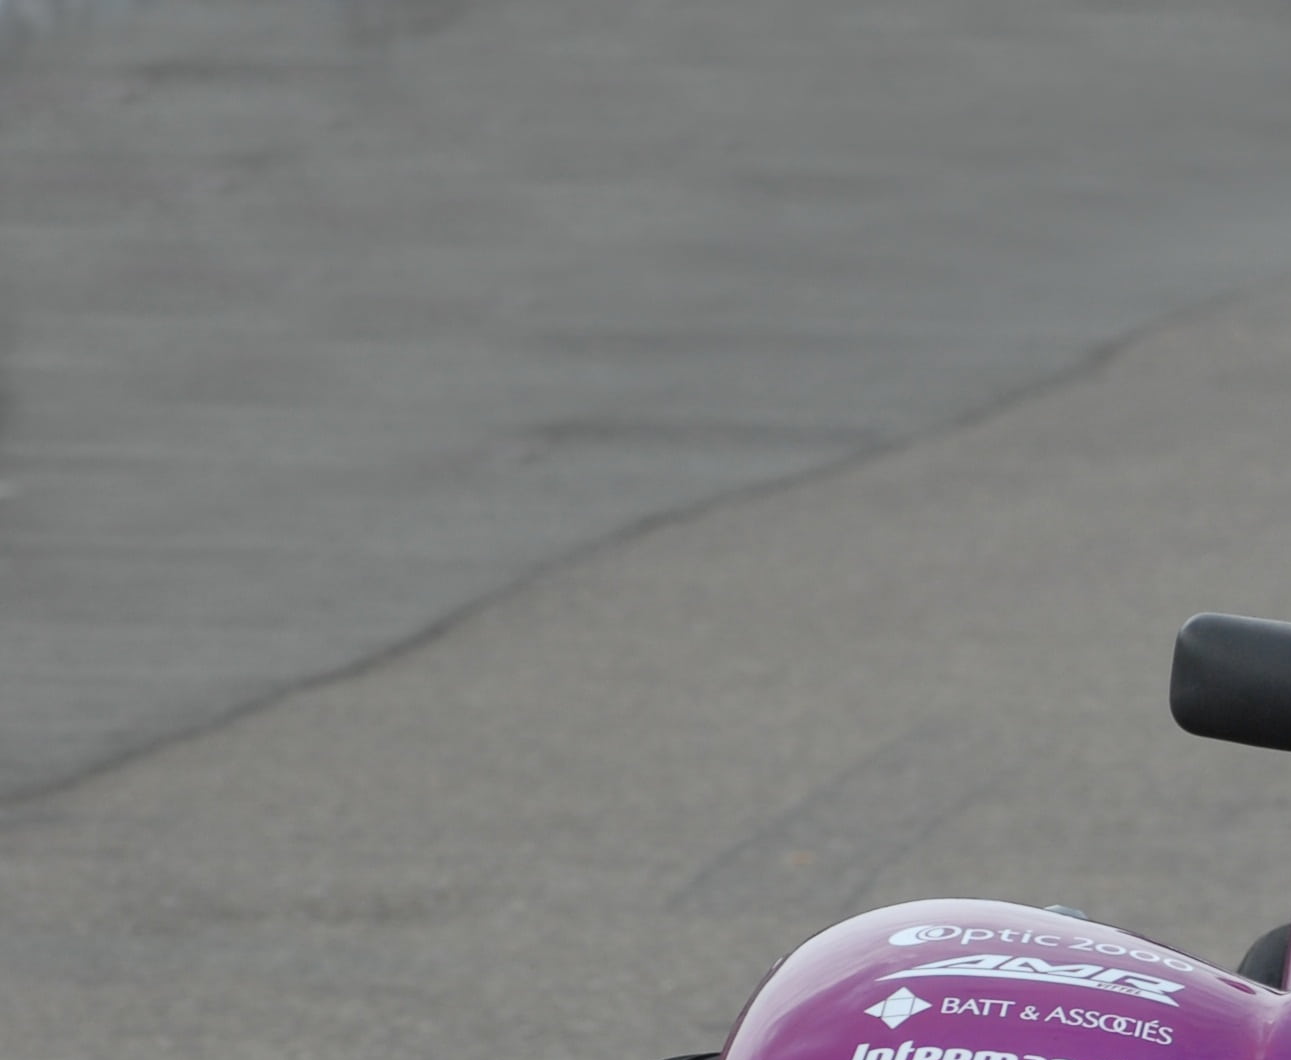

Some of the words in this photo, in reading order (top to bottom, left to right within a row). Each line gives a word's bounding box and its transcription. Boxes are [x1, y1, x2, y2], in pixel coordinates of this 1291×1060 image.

[897, 925, 1061, 947] Optic
[1068, 936, 1195, 973] 2000
[940, 997, 1017, 1018] BATT
[1019, 1005, 1040, 1022] &
[1044, 1006, 1174, 1046] ASSOCIÉS
